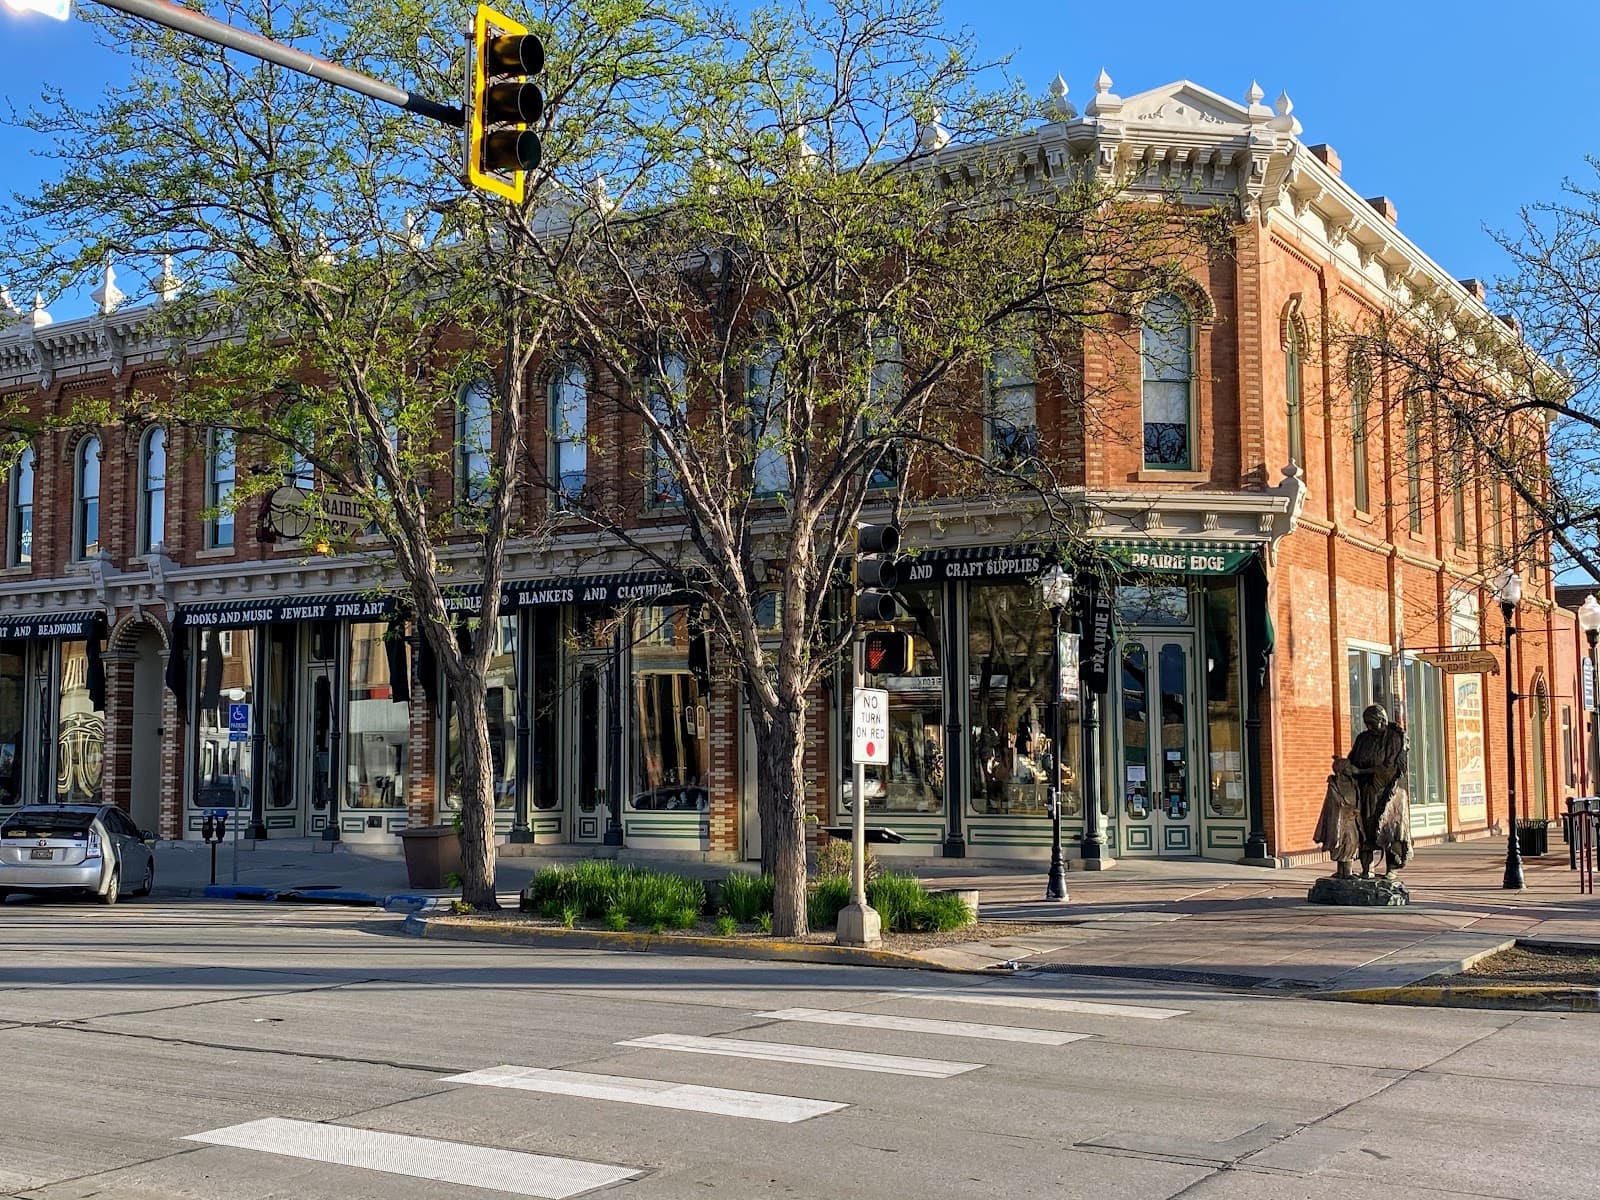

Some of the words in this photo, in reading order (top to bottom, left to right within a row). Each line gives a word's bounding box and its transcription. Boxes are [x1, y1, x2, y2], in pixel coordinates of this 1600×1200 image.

[314, 497, 366, 519] RAIRIE
[909, 564, 933, 580] AND
[945, 562, 983, 577] CRAFT
[986, 557, 1040, 575] SUPPLIES
[1131, 553, 1187, 570] PRAIRIE
[1190, 556, 1225, 571] EDGE
[518, 589, 574, 604] BLANKETS
[583, 587, 607, 601] AND
[184, 613, 217, 625] BOOKS
[219, 611, 241, 623] AND
[242, 609, 273, 622] MUSIC
[280, 605, 327, 619] JEWELRY
[335, 603, 361, 617] FINE
[362, 602, 385, 616] ART
[13, 625, 32, 638] AND
[38, 623, 83, 636] BEADWORK
[1093, 613, 1109, 673] PRAIRIE
[1435, 653, 1470, 663] PRAIRIE
[1447, 662, 1470, 672] EDGE
[863, 696, 878, 709] NO
[861, 711, 881, 724] TURN
[856, 726, 867, 738] ON
[870, 728, 885, 740] RED
